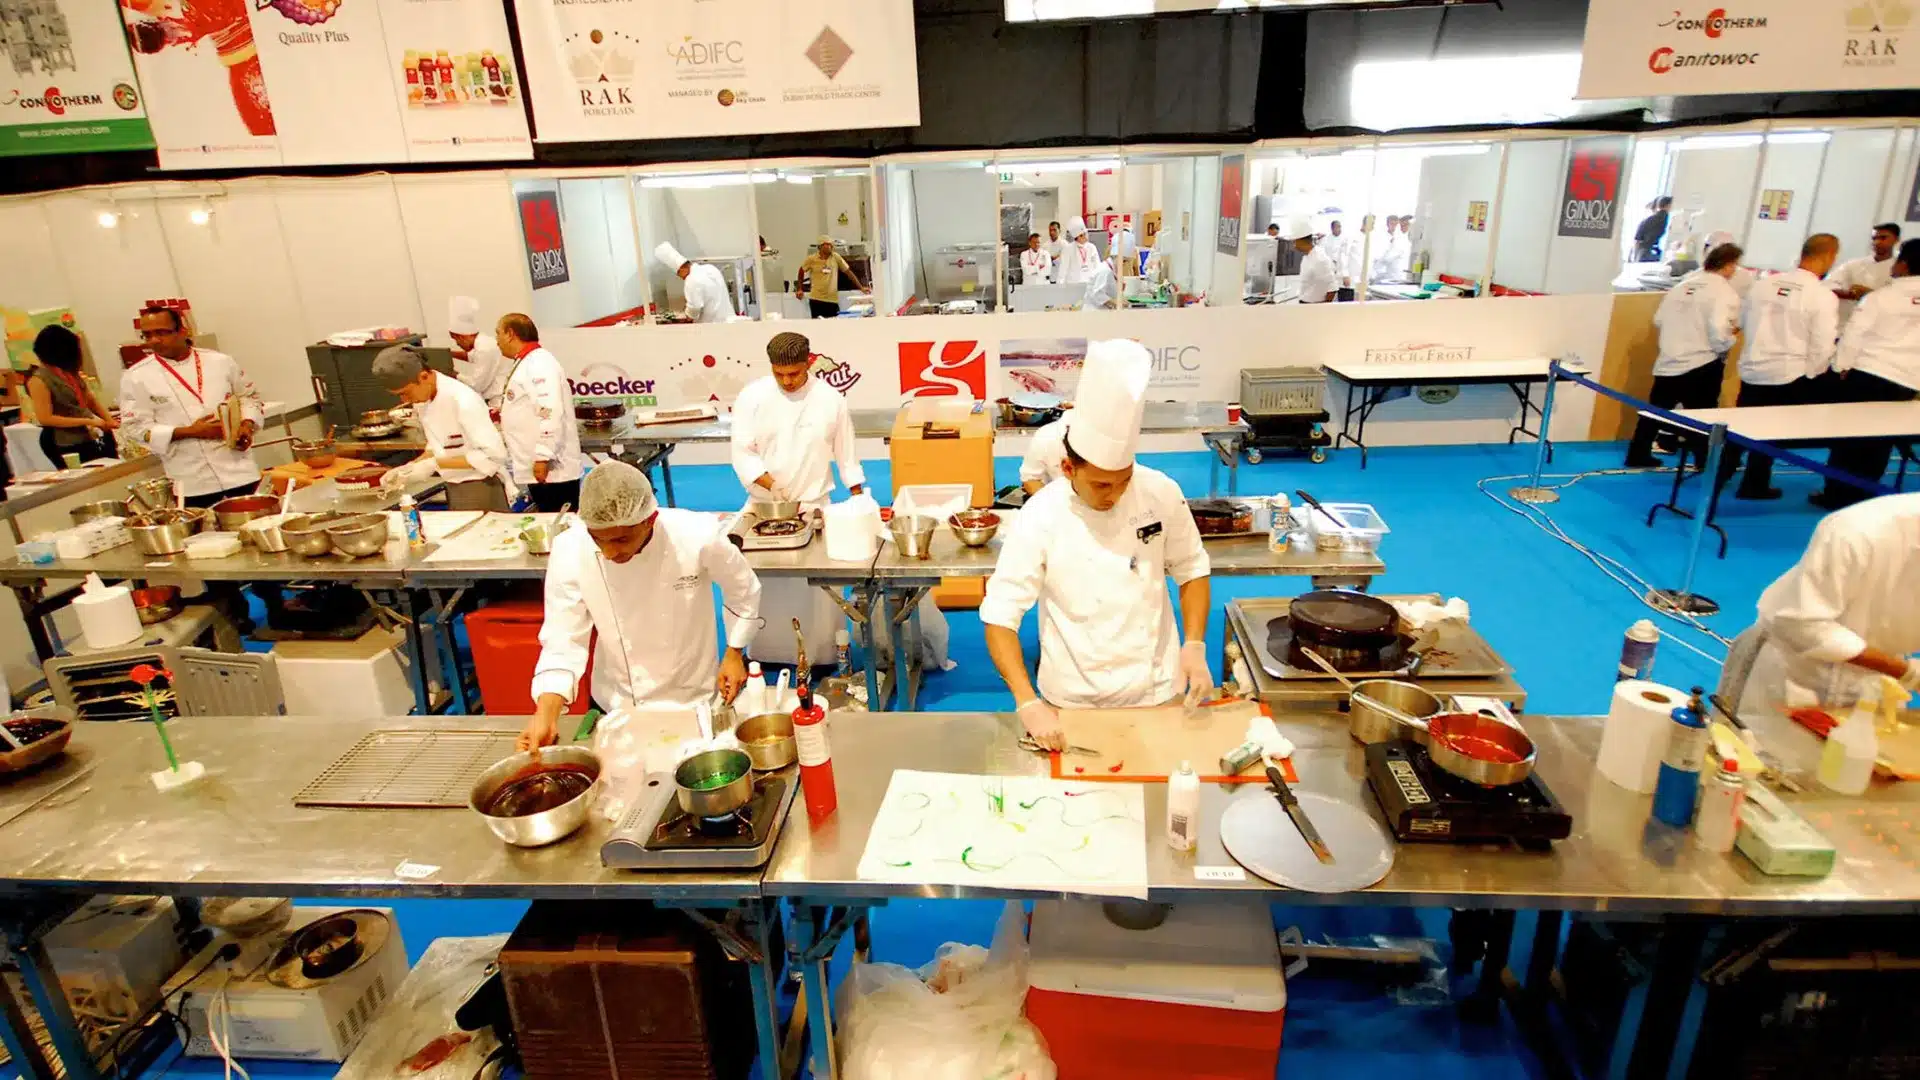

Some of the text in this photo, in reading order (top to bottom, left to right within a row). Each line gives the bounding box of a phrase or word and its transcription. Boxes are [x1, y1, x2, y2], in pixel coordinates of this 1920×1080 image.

[279, 30, 350, 45] Quality Plus
[1845, 38, 1899, 56] RAK
[675, 41, 744, 66] ADIFC
[580, 87, 633, 105] RAK
[1565, 199, 1613, 220] GINOX
[531, 249, 563, 272] GINOX
